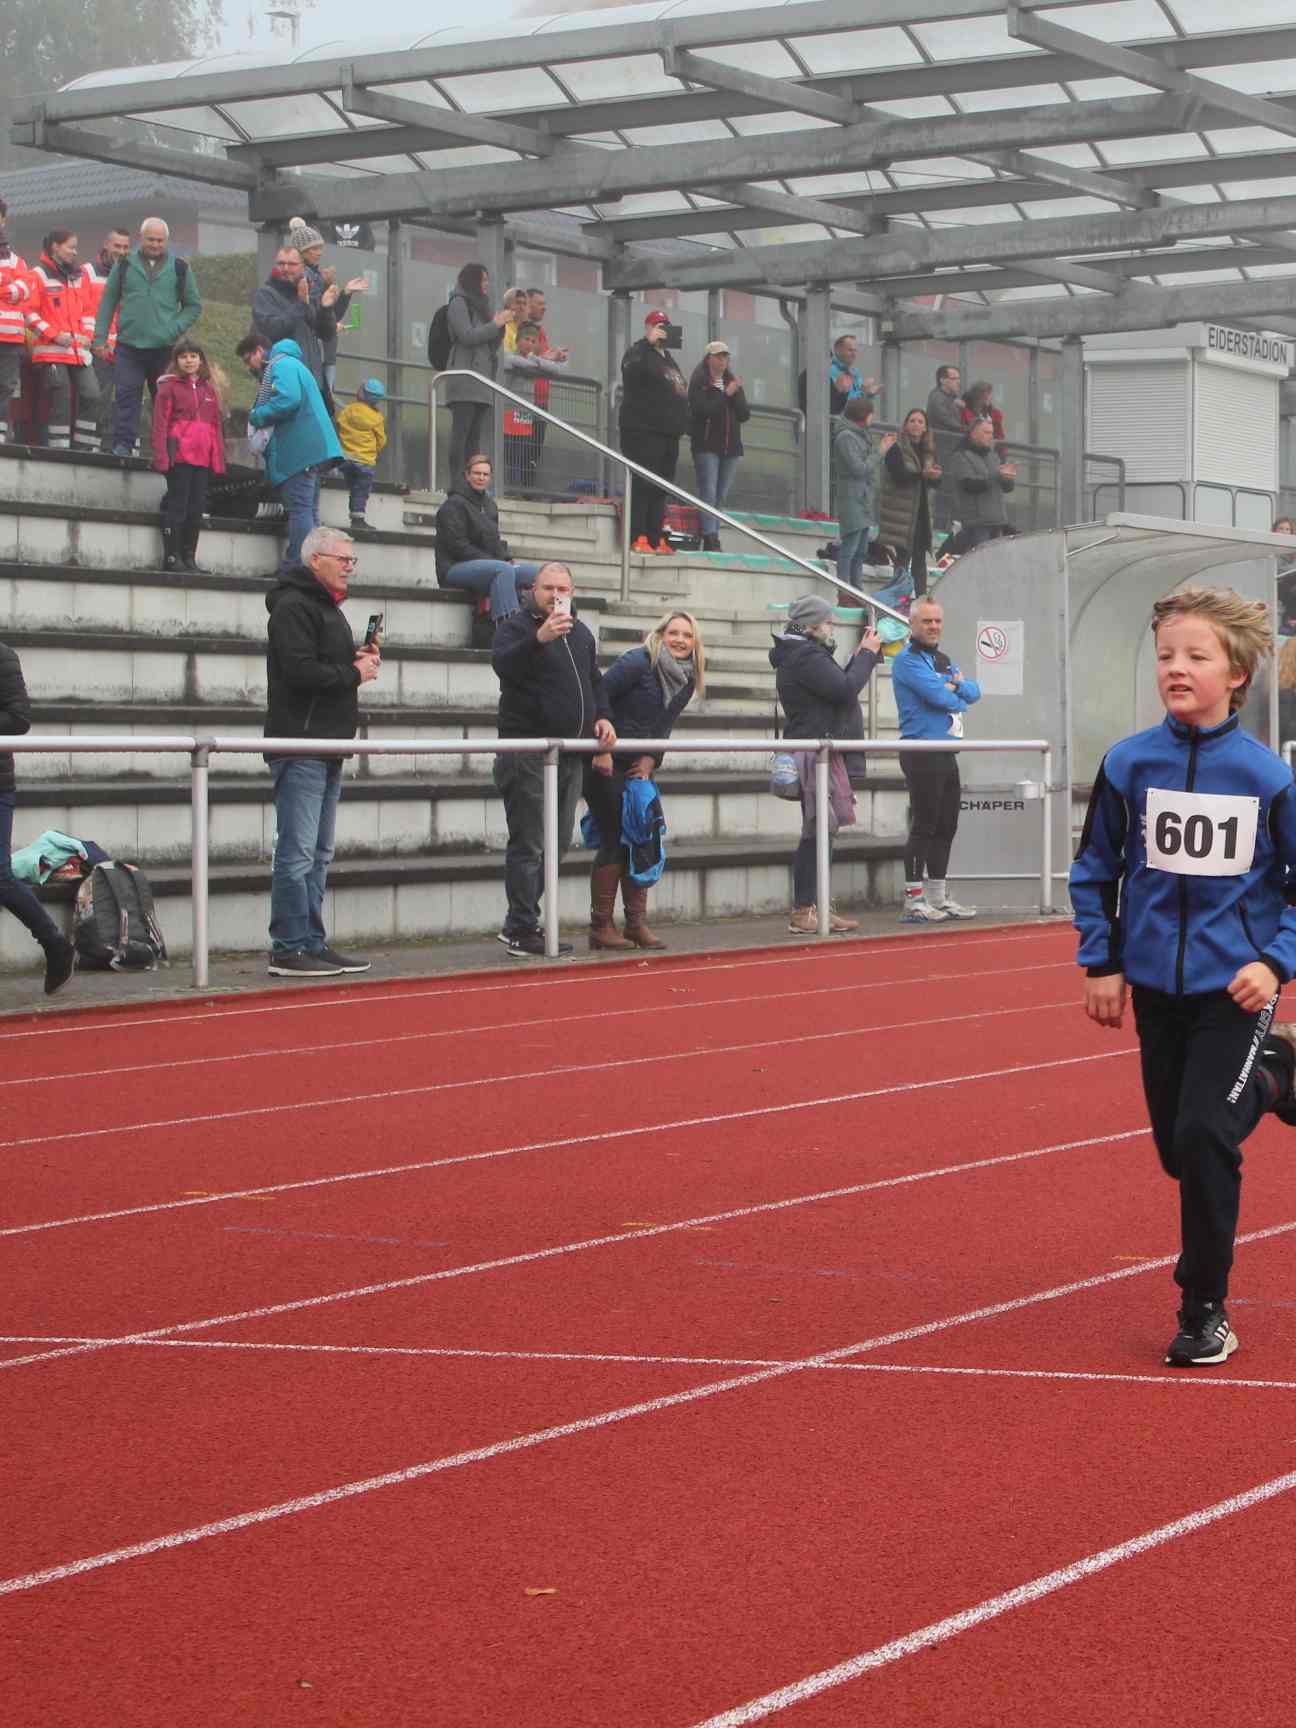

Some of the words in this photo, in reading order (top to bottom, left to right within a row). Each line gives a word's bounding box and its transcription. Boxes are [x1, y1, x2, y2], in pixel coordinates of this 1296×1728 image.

[1208, 327, 1287, 364] EIDERSTADION
[960, 800, 1025, 811] CHÄPER
[1155, 811, 1239, 860] 601
